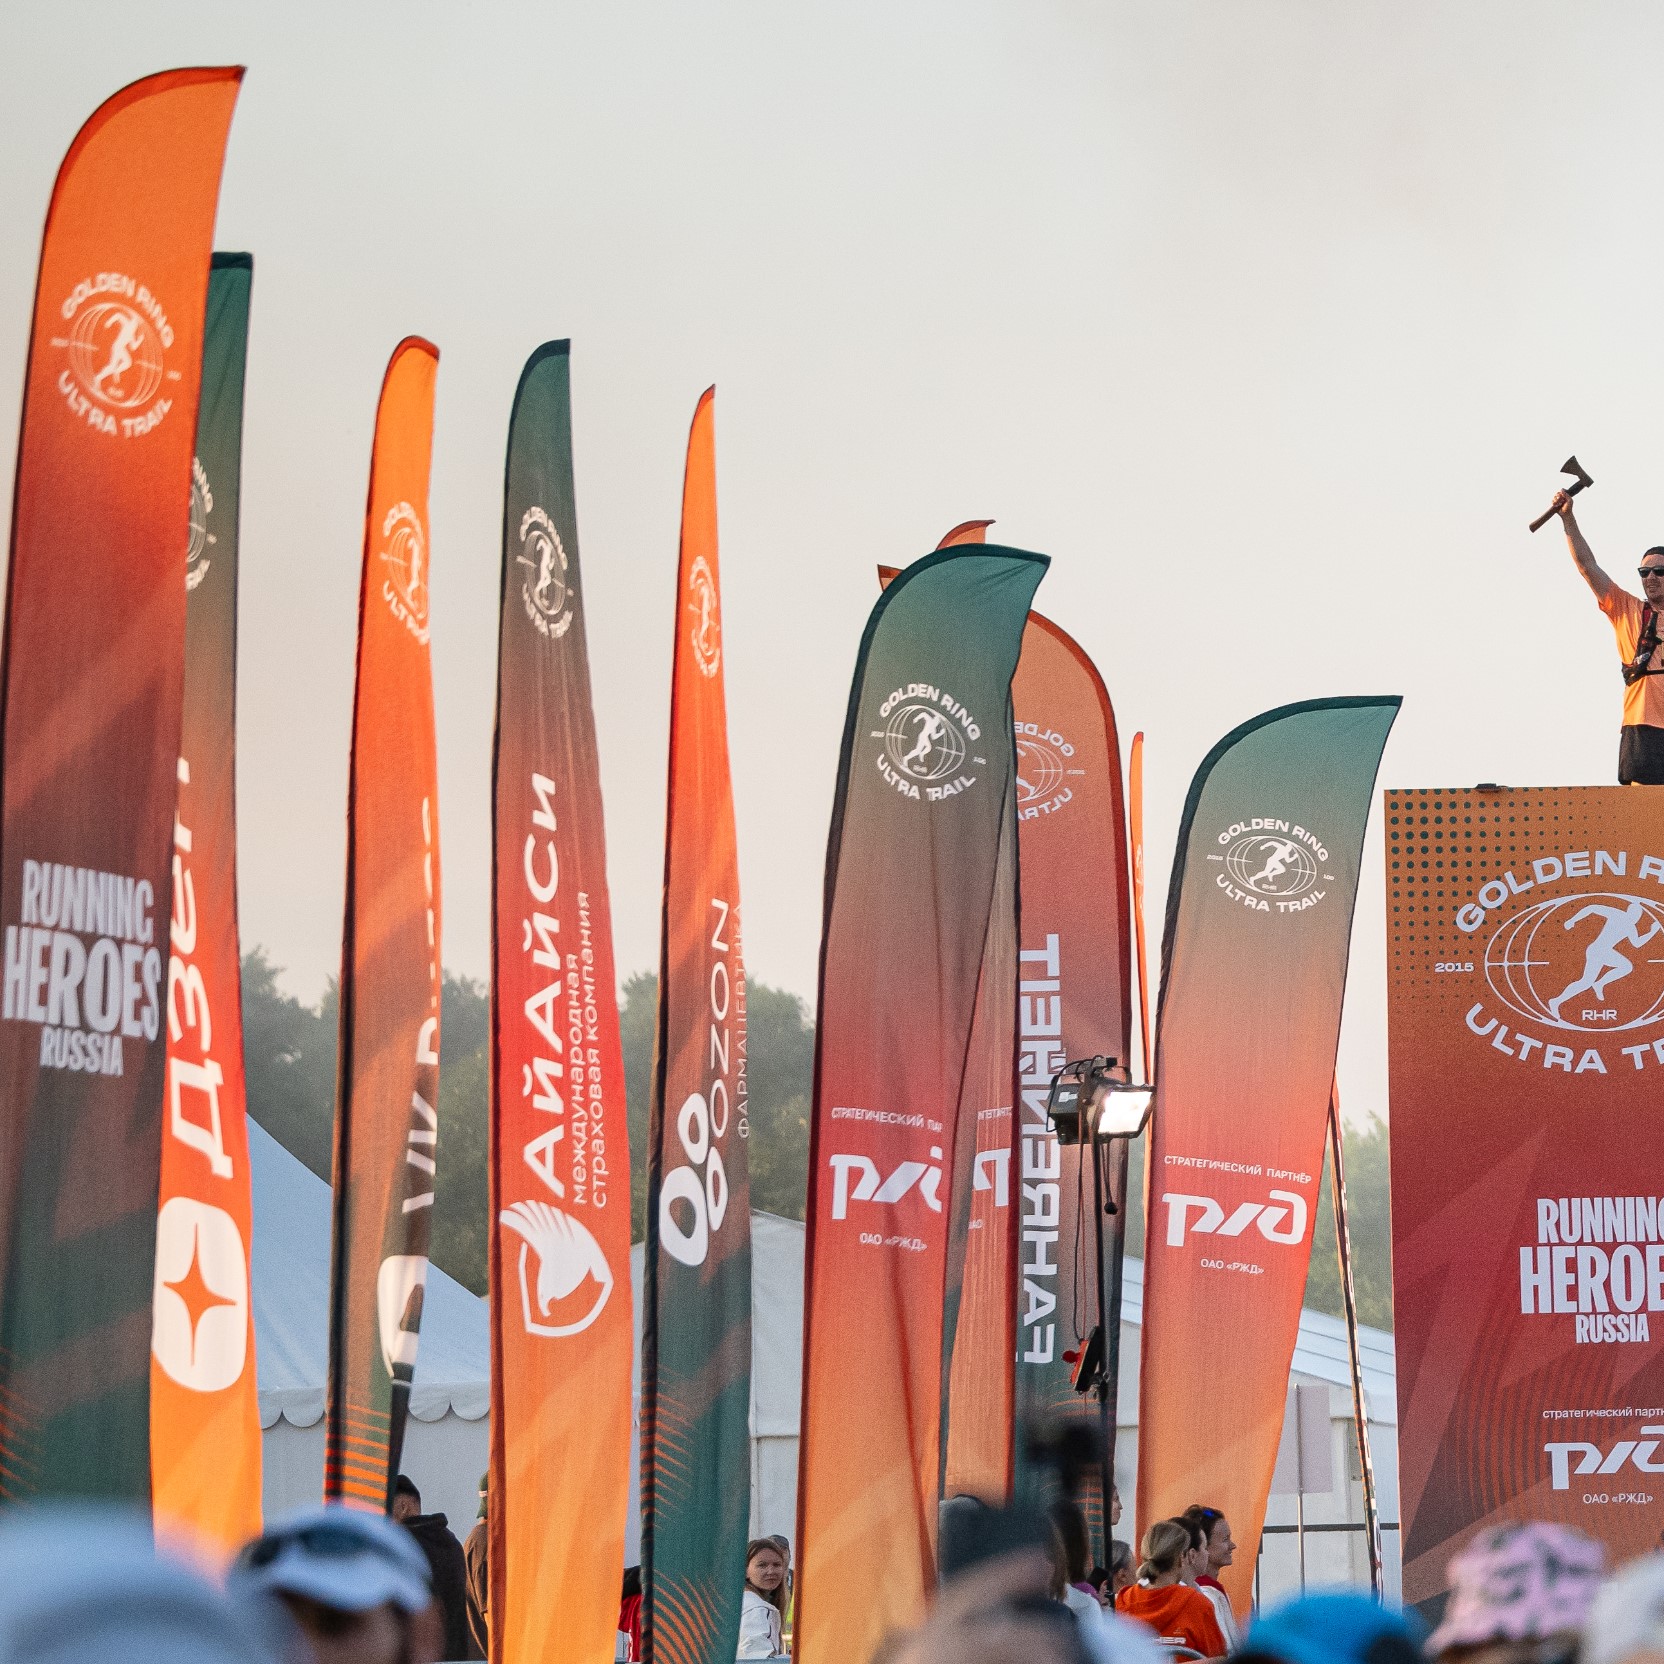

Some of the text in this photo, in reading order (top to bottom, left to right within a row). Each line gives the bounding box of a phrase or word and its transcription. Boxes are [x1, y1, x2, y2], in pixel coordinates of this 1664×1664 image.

[60, 272, 174, 348] GOLDEN RING
[58, 370, 173, 438] ULTRA TRAIL
[879, 683, 981, 740] GOLDEN RING
[876, 753, 977, 801] ULTRA TRAIL
[1217, 818, 1329, 861] GOLDEN RING
[21, 860, 154, 944] RUNNING
[1216, 874, 1326, 912] ULTRA TRAIL
[1455, 850, 1627, 933] GOLDEN
[3, 925, 162, 1041] HEROES
[523, 772, 566, 1199] АЙАЙСИ
[1434, 962, 1474, 972] 2015
[711, 898, 729, 1138] OZON
[1465, 1002, 1608, 1074] ULTRA
[1582, 1009, 1618, 1021] RHR
[39, 1025, 124, 1077] RUSSIA
[577, 890, 607, 1208] страховая компания
[566, 953, 588, 1205] международная
[1164, 1155, 1312, 1184] СТРАТЕГИЧЕСКИЙ ПАРТНЁР
[860, 1232, 882, 1245] ОАО
[1200, 1258, 1264, 1275] ОАО «РЖД»
[1575, 1313, 1650, 1344] RUSSIA
[1542, 1407, 1633, 1420] стратегический
[1583, 1493, 1653, 1504] ОАО «РЖД»
